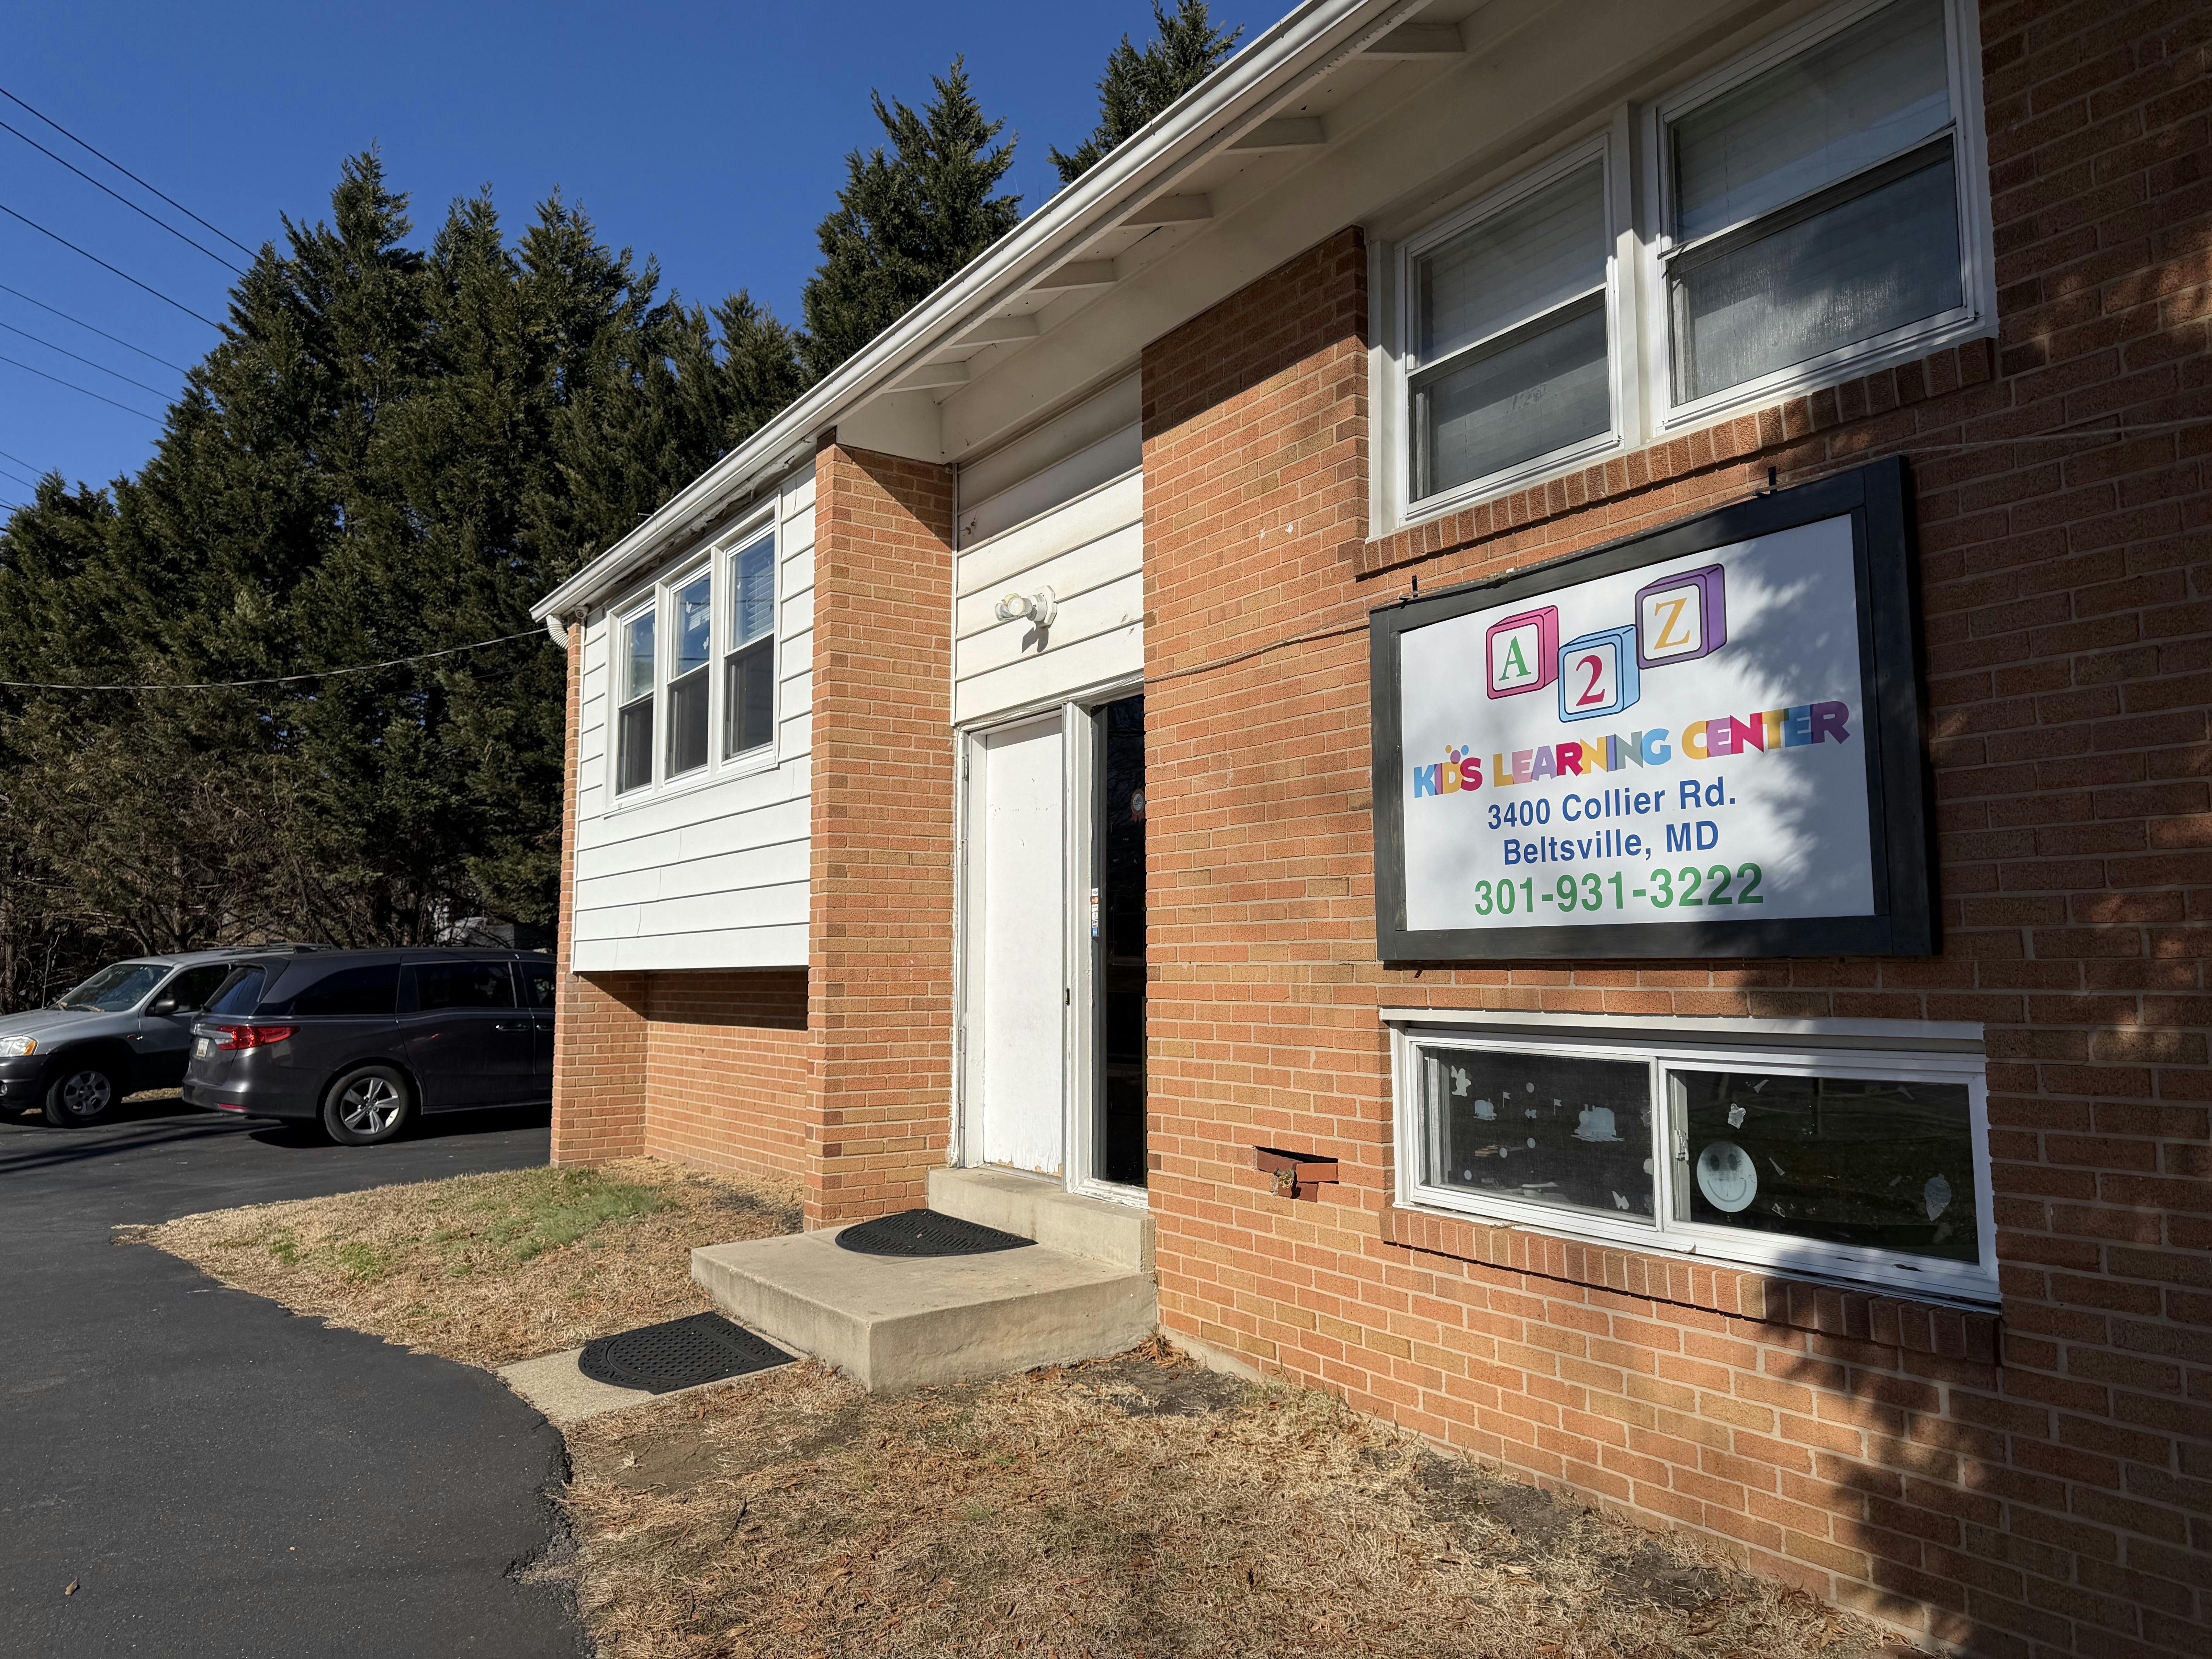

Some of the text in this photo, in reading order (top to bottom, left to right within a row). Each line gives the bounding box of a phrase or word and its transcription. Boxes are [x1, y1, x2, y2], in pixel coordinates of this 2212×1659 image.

[1493, 728, 1671, 787] LEARNING
[1681, 701, 1850, 759] CENTER
[1488, 776, 1736, 830] 3400 Collier Rd.
[1504, 821, 1719, 865] Beltsville, MD
[1476, 863, 1764, 915] 301-931-3222
